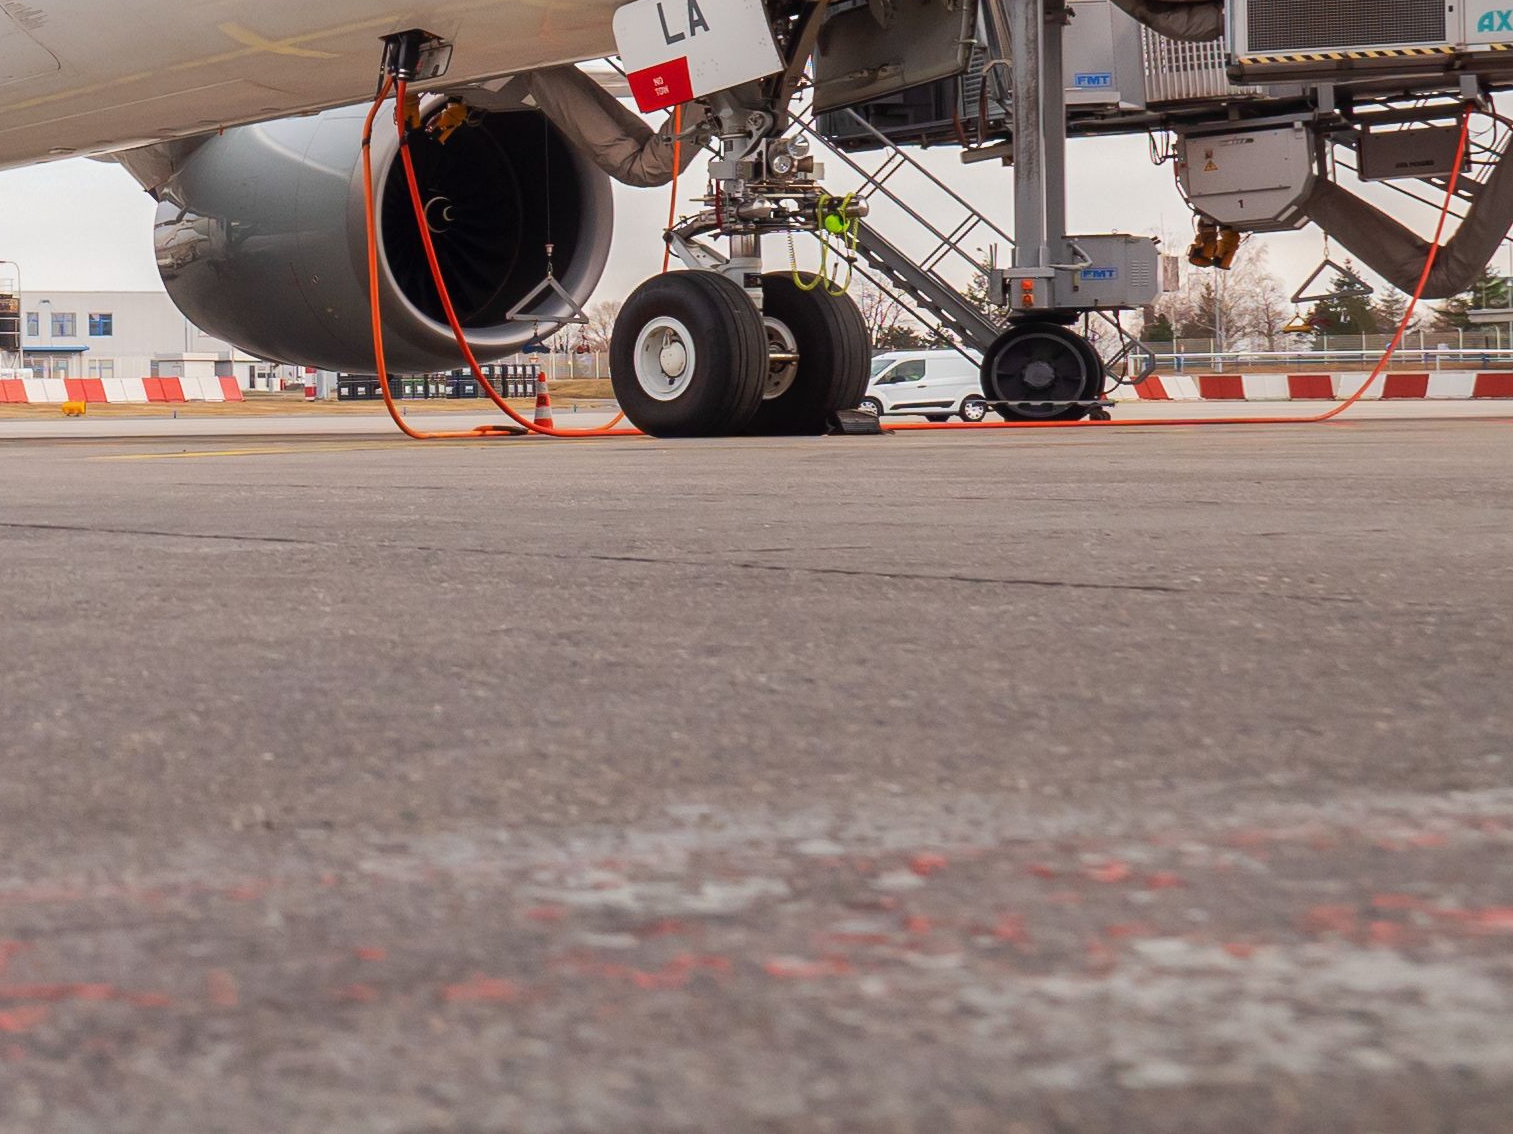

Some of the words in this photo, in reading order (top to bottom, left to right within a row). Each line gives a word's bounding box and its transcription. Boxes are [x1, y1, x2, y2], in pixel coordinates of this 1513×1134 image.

[653, 76, 664, 86] NO
[1077, 75, 1110, 85] FMT
[1083, 269, 1114, 277] FMT
